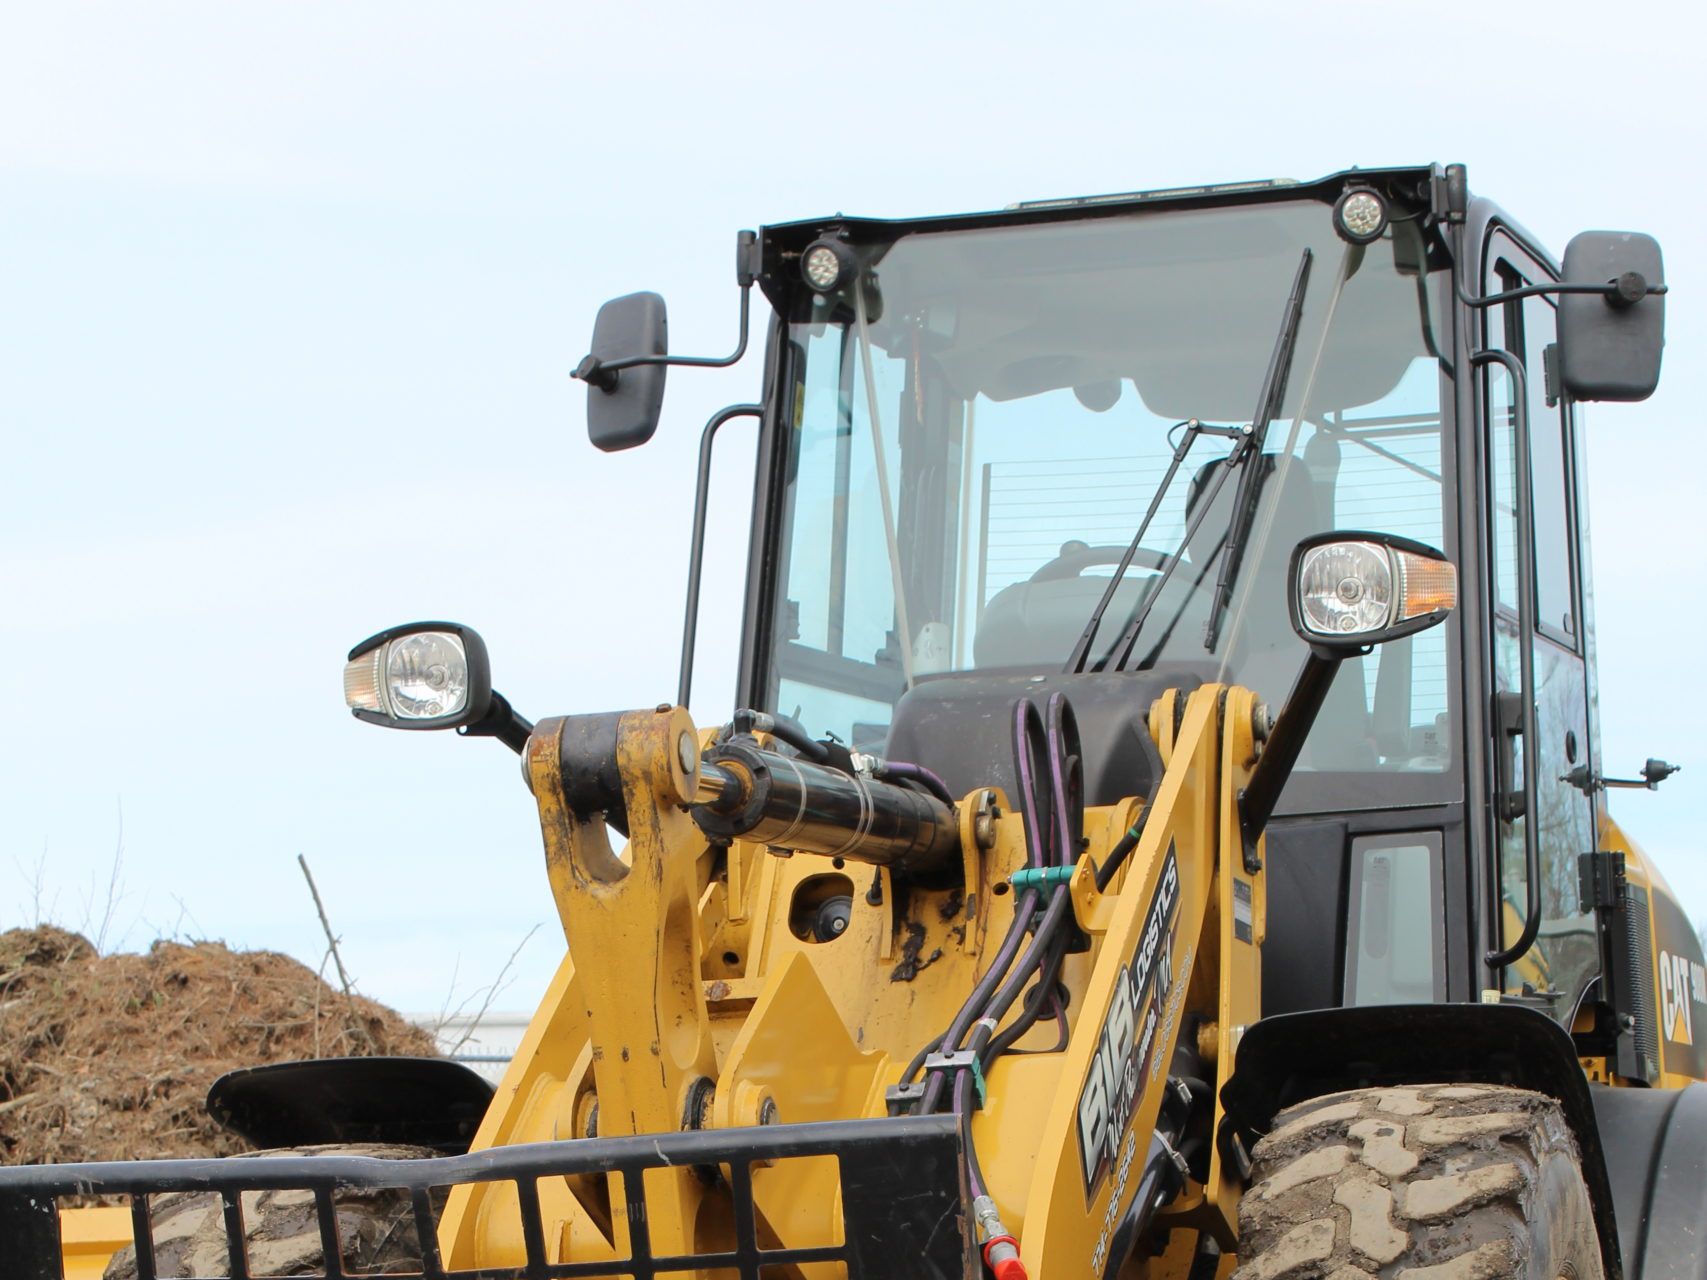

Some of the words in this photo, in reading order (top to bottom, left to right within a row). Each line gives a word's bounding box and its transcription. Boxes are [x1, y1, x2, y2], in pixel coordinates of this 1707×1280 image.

[1079, 968, 1134, 1185] BIB
[1131, 855, 1176, 1010] LOGISTICS
[1660, 950, 1693, 1046] CAT
